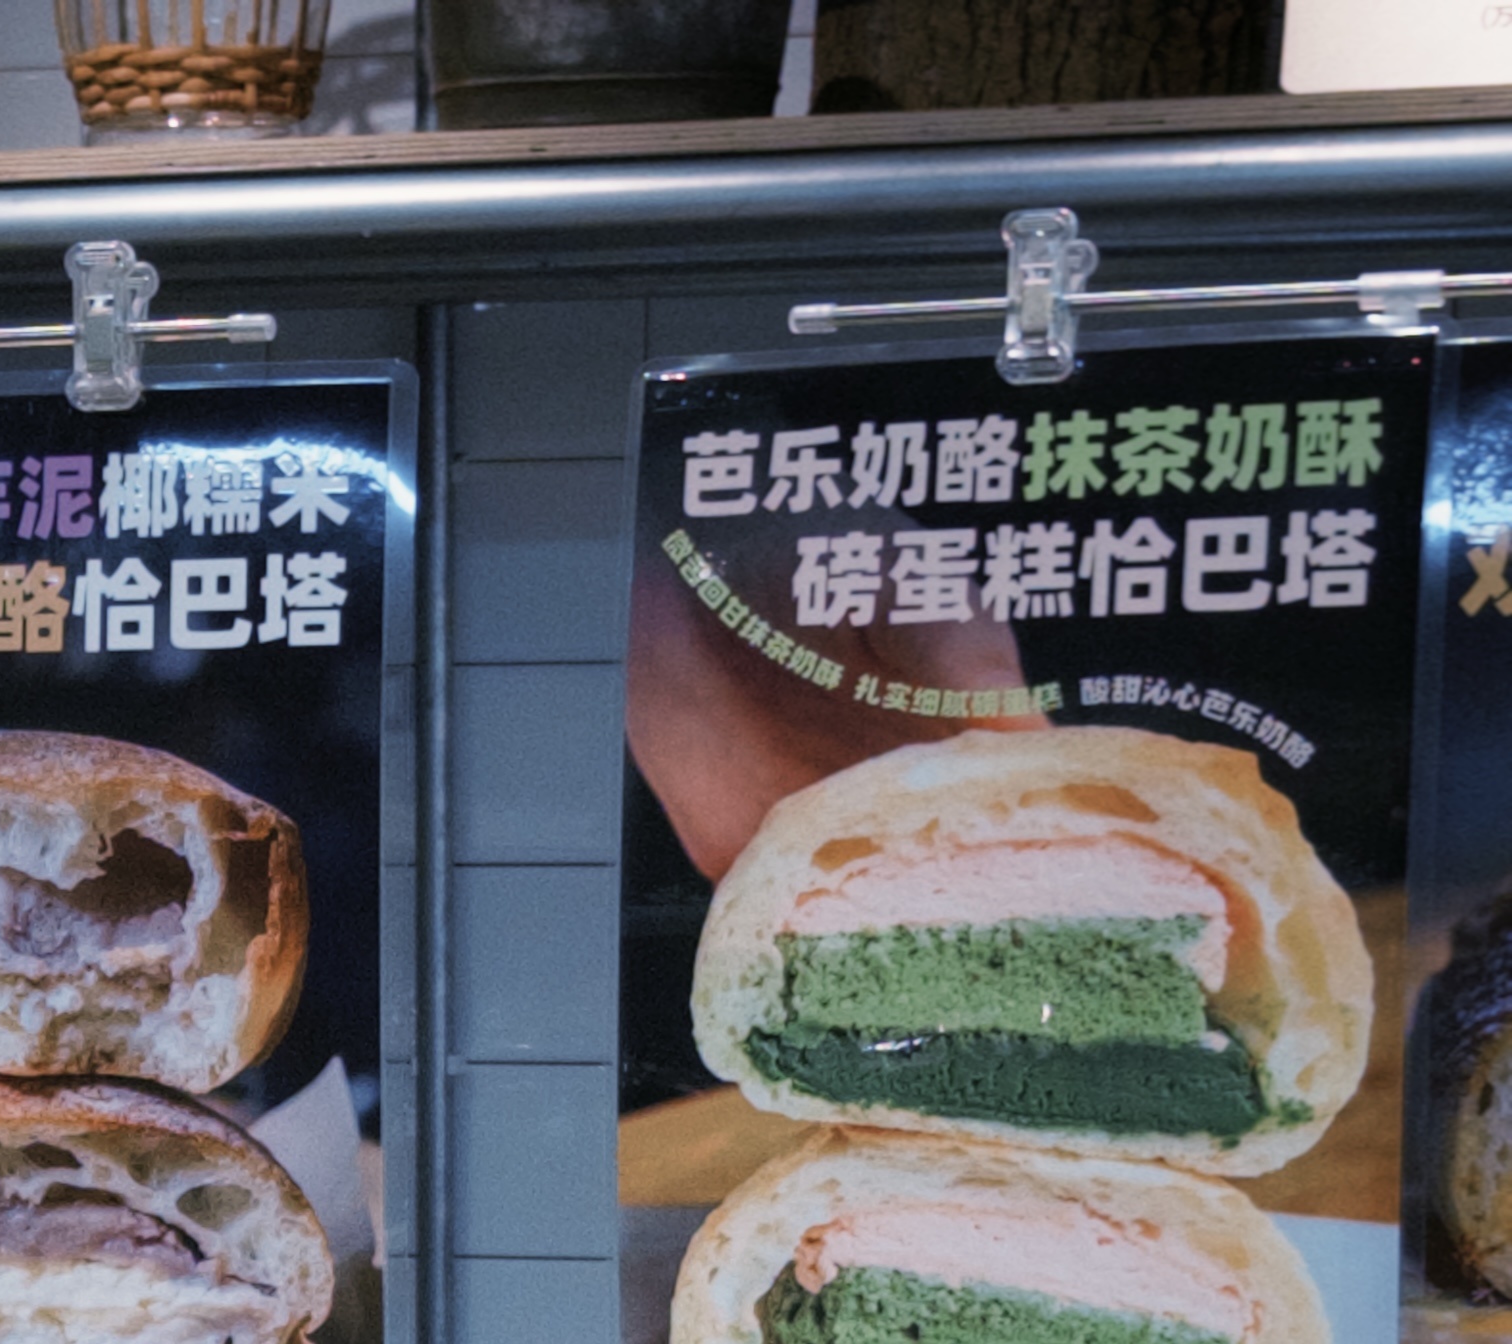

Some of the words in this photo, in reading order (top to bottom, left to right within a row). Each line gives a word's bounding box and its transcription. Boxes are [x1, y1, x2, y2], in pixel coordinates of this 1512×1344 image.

[682, 397, 1385, 518] 芭乐奶酪抹茶奶酥
[791, 508, 1378, 630] 磅蛋糕恰巴塔
[1078, 675, 1317, 770] 酸甜沁心芭乐奶酪
